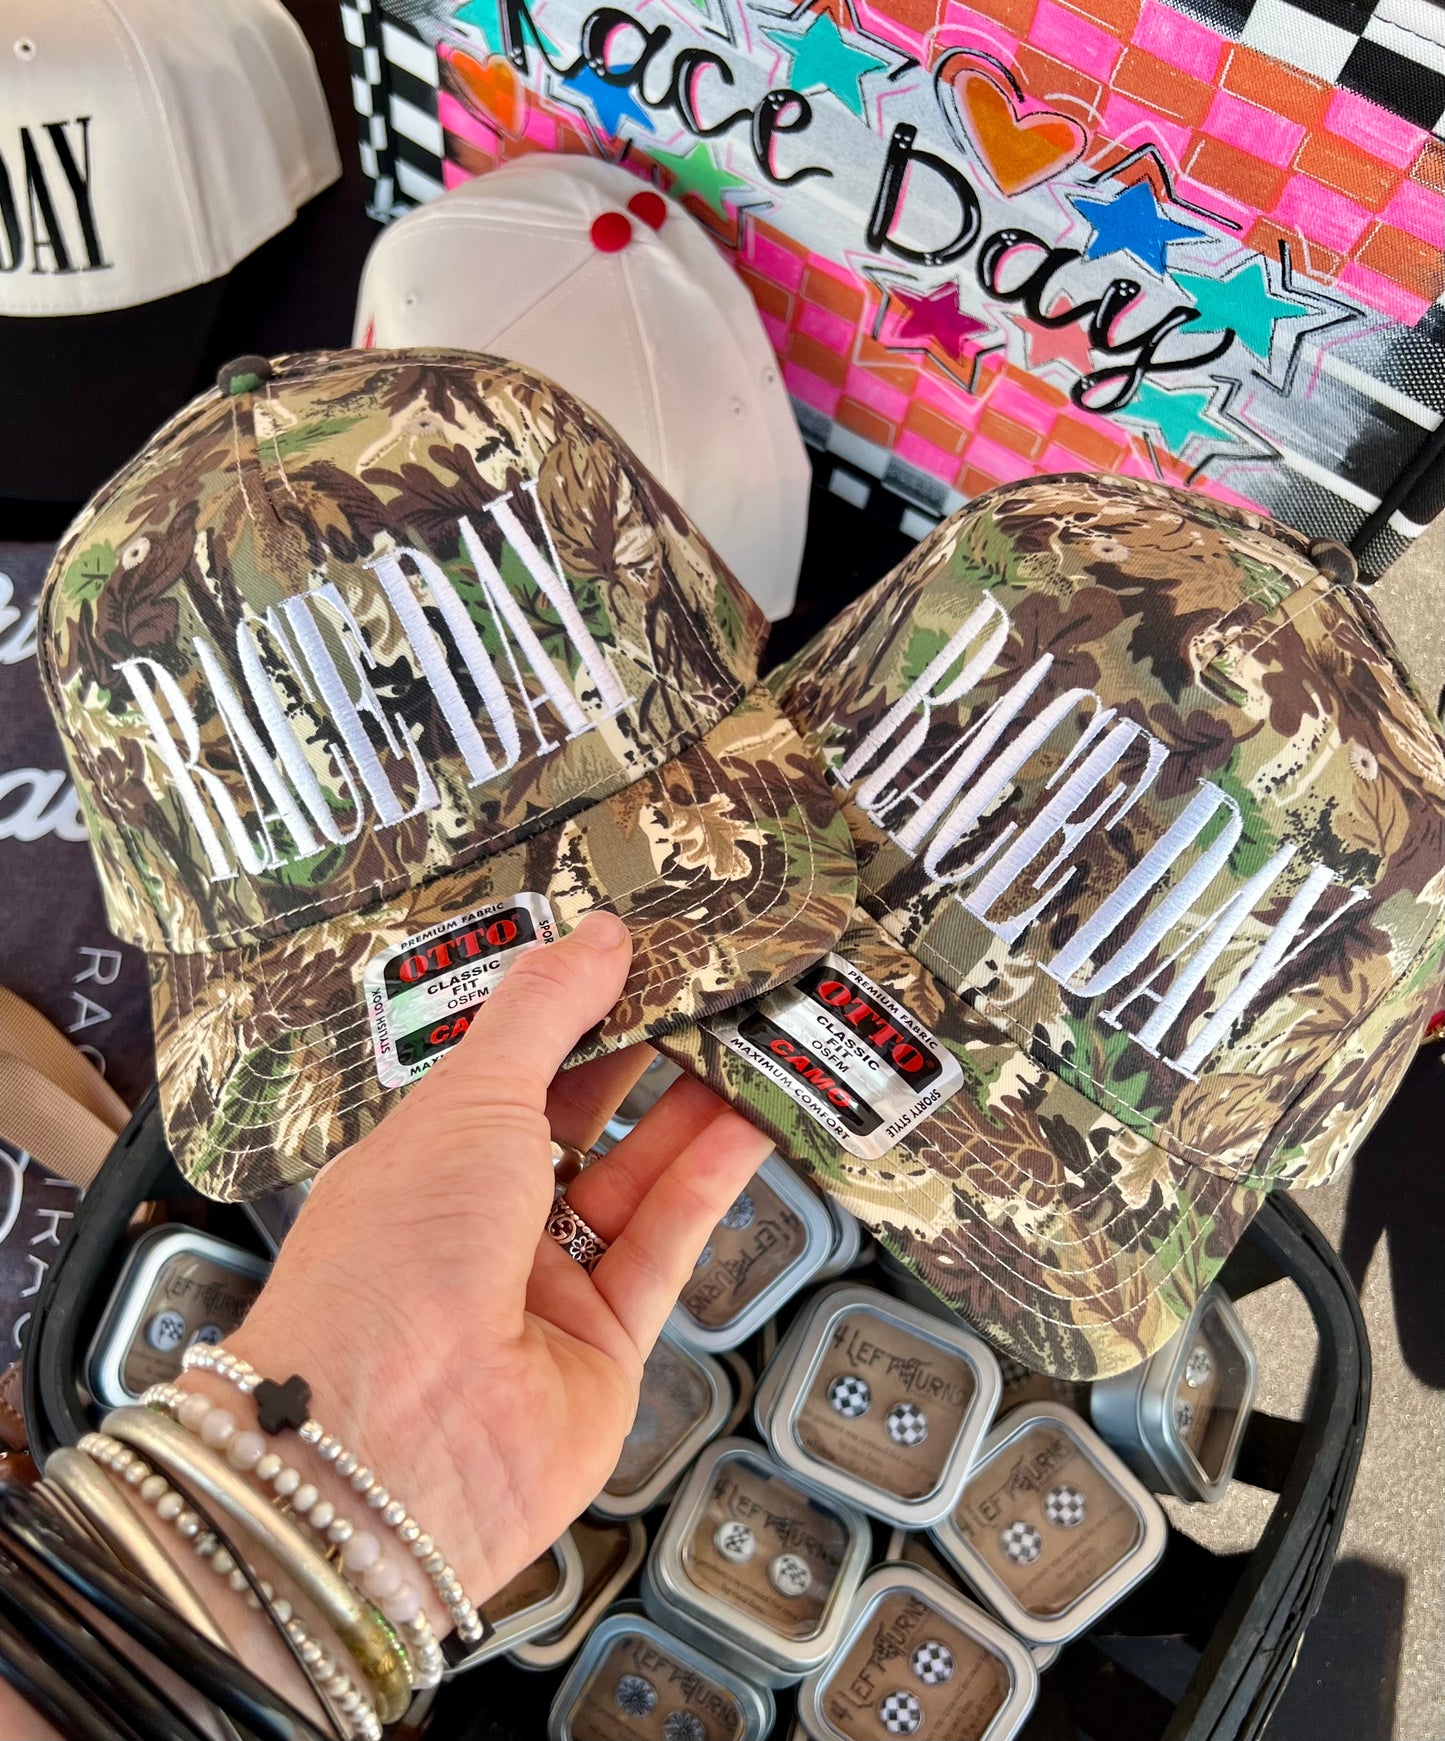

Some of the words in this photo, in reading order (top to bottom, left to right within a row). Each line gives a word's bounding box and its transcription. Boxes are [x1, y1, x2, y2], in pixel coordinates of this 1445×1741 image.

[866, 121, 1236, 414] Day
[400, 919, 457, 950] PREMIUM
[461, 902, 505, 927] FABRIC
[427, 959, 501, 996] CLASSIC
[452, 978, 479, 997] FIT
[371, 987, 385, 1016] LOOK
[447, 986, 490, 1010] OSFM
[847, 970, 899, 1015] PREMIUM
[900, 1013, 938, 1050] FABRIC
[375, 1015, 391, 1055] STYLISH
[816, 1014, 881, 1071] CLASSIC
[826, 1037, 852, 1060] FIT
[768, 1039, 852, 1107] CAMO
[811, 1039, 850, 1073] OSFM
[730, 1037, 792, 1089] MAXIMUM
[794, 1088, 851, 1141] COMFORT
[910, 1088, 942, 1119] SPORTY
[885, 1113, 912, 1138] STYLE
